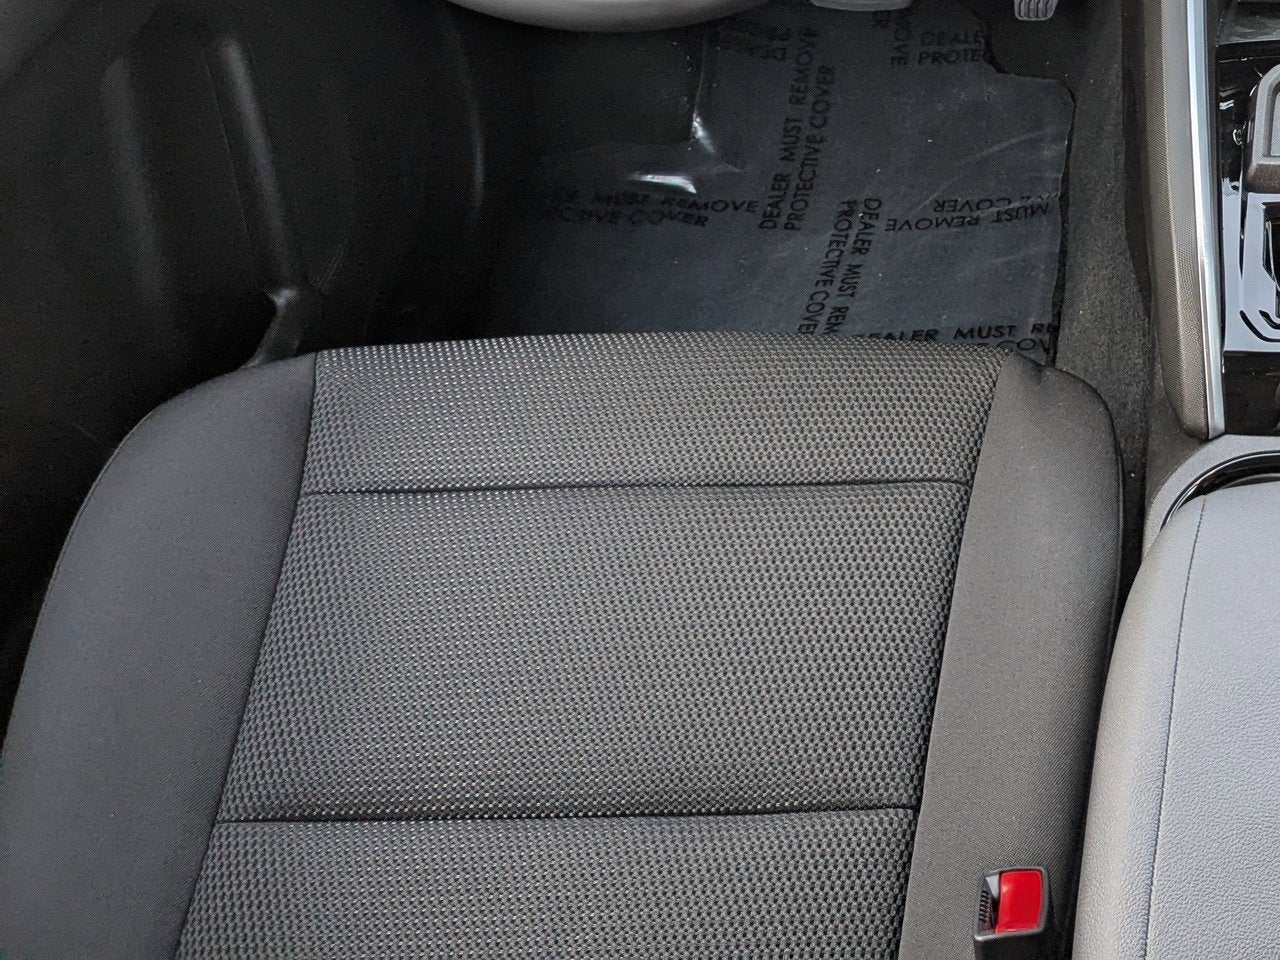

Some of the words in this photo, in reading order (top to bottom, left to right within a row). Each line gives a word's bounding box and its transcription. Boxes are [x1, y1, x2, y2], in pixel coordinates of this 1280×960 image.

[783, 134, 827, 231] PROTECTIVE
[808, 64, 836, 130] COVER
[758, 172, 792, 230] DEALER
[779, 115, 801, 165] MUST
[885, 213, 982, 233] REMOVE
[931, 197, 1013, 213] COVER
[992, 201, 1052, 224] MUST
[815, 198, 858, 290] PROTECTIVE
[849, 197, 882, 257] DEALER
[834, 261, 864, 299] MUST
[952, 324, 1019, 341] MUST
